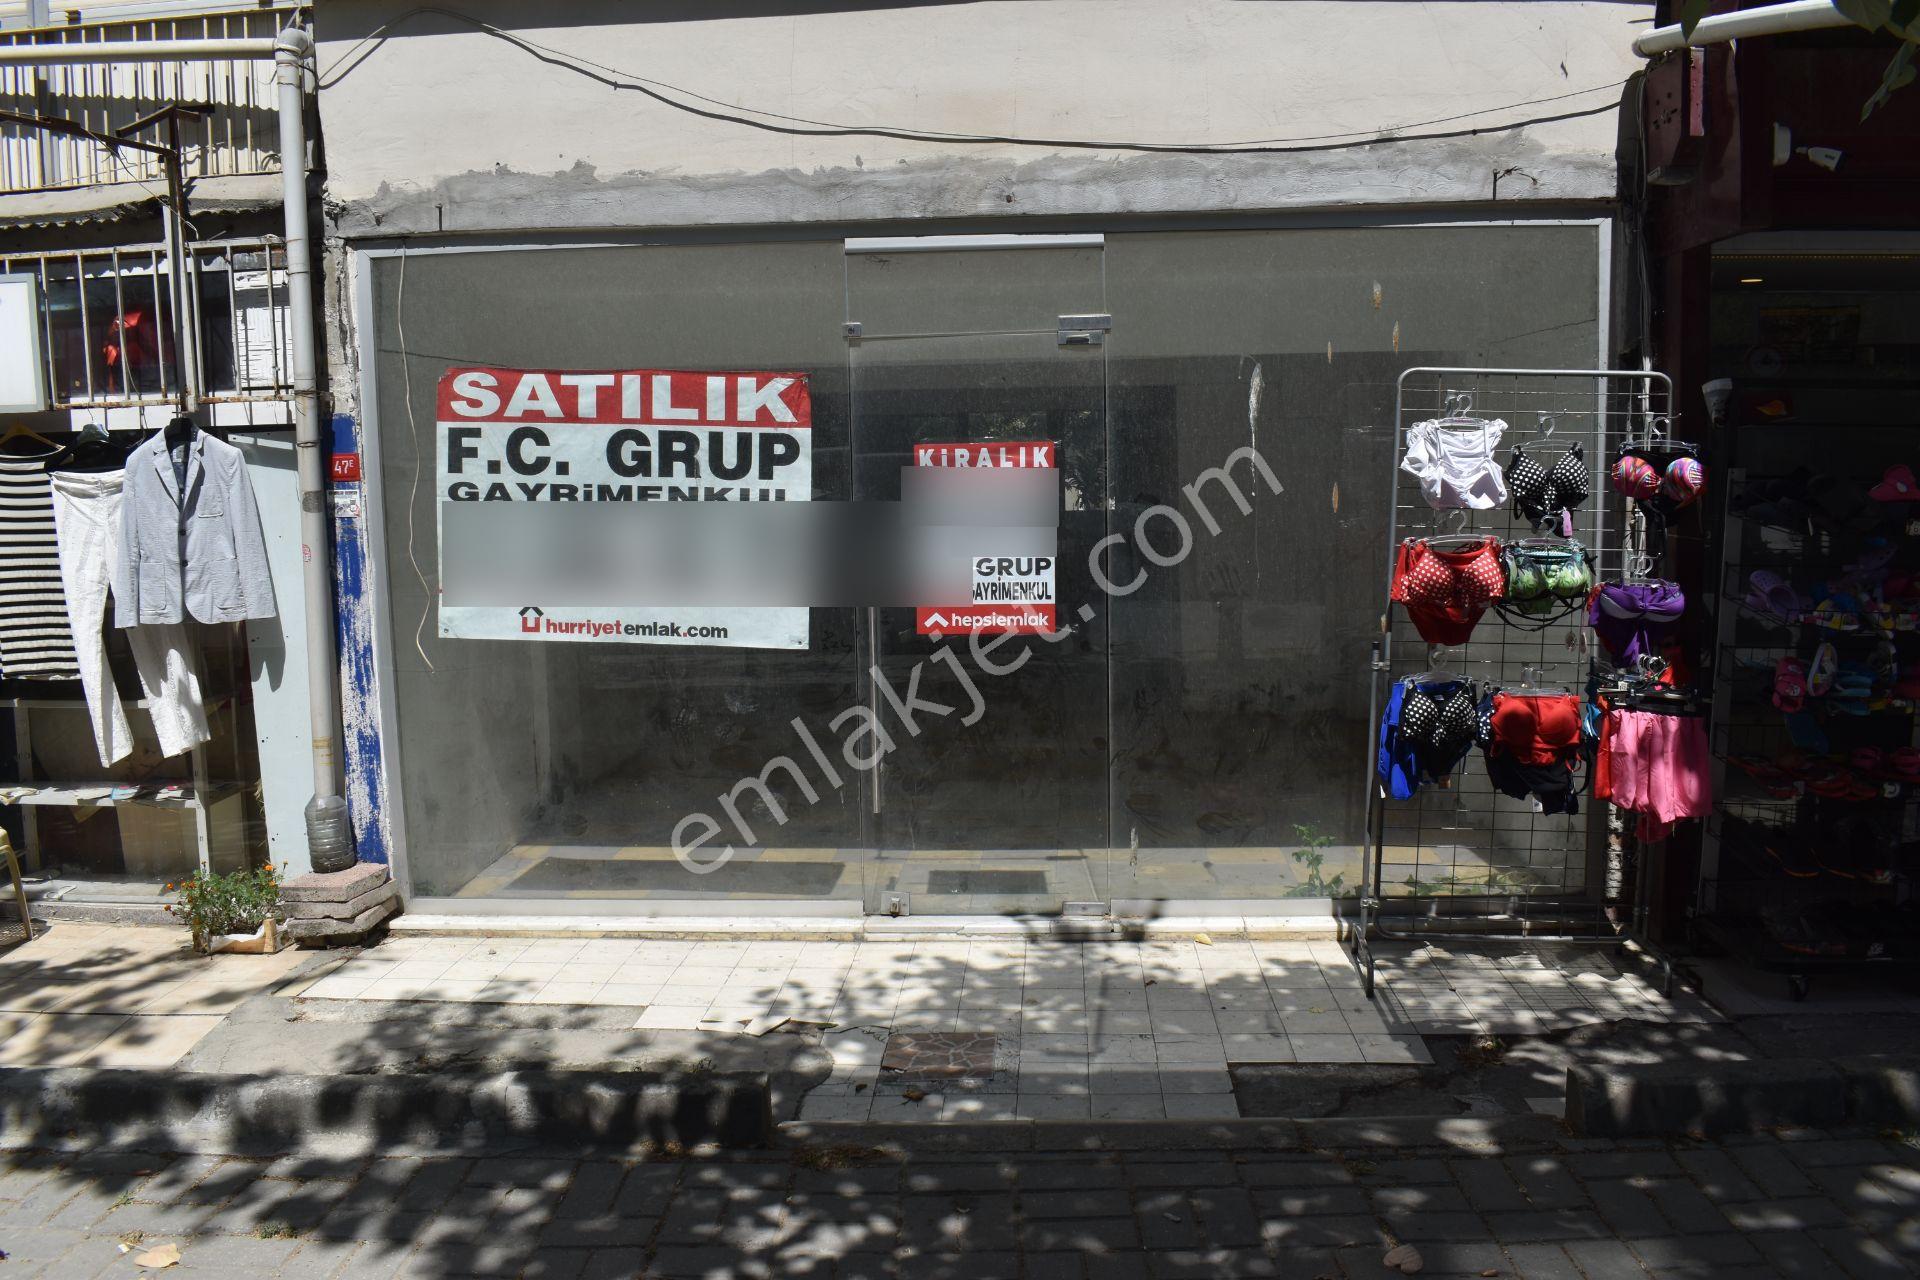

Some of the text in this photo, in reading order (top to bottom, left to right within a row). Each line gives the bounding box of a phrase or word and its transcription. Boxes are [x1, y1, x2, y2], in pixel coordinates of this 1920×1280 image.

[450, 372, 799, 423] SATILIK
[447, 426, 801, 481] F.C. GRUP
[975, 557, 1052, 577] GRUP
[972, 577, 1052, 601] AYRİMENKUL
[545, 618, 728, 639] hurriyetemlak.com
[951, 612, 1049, 629] hepsiemlak
